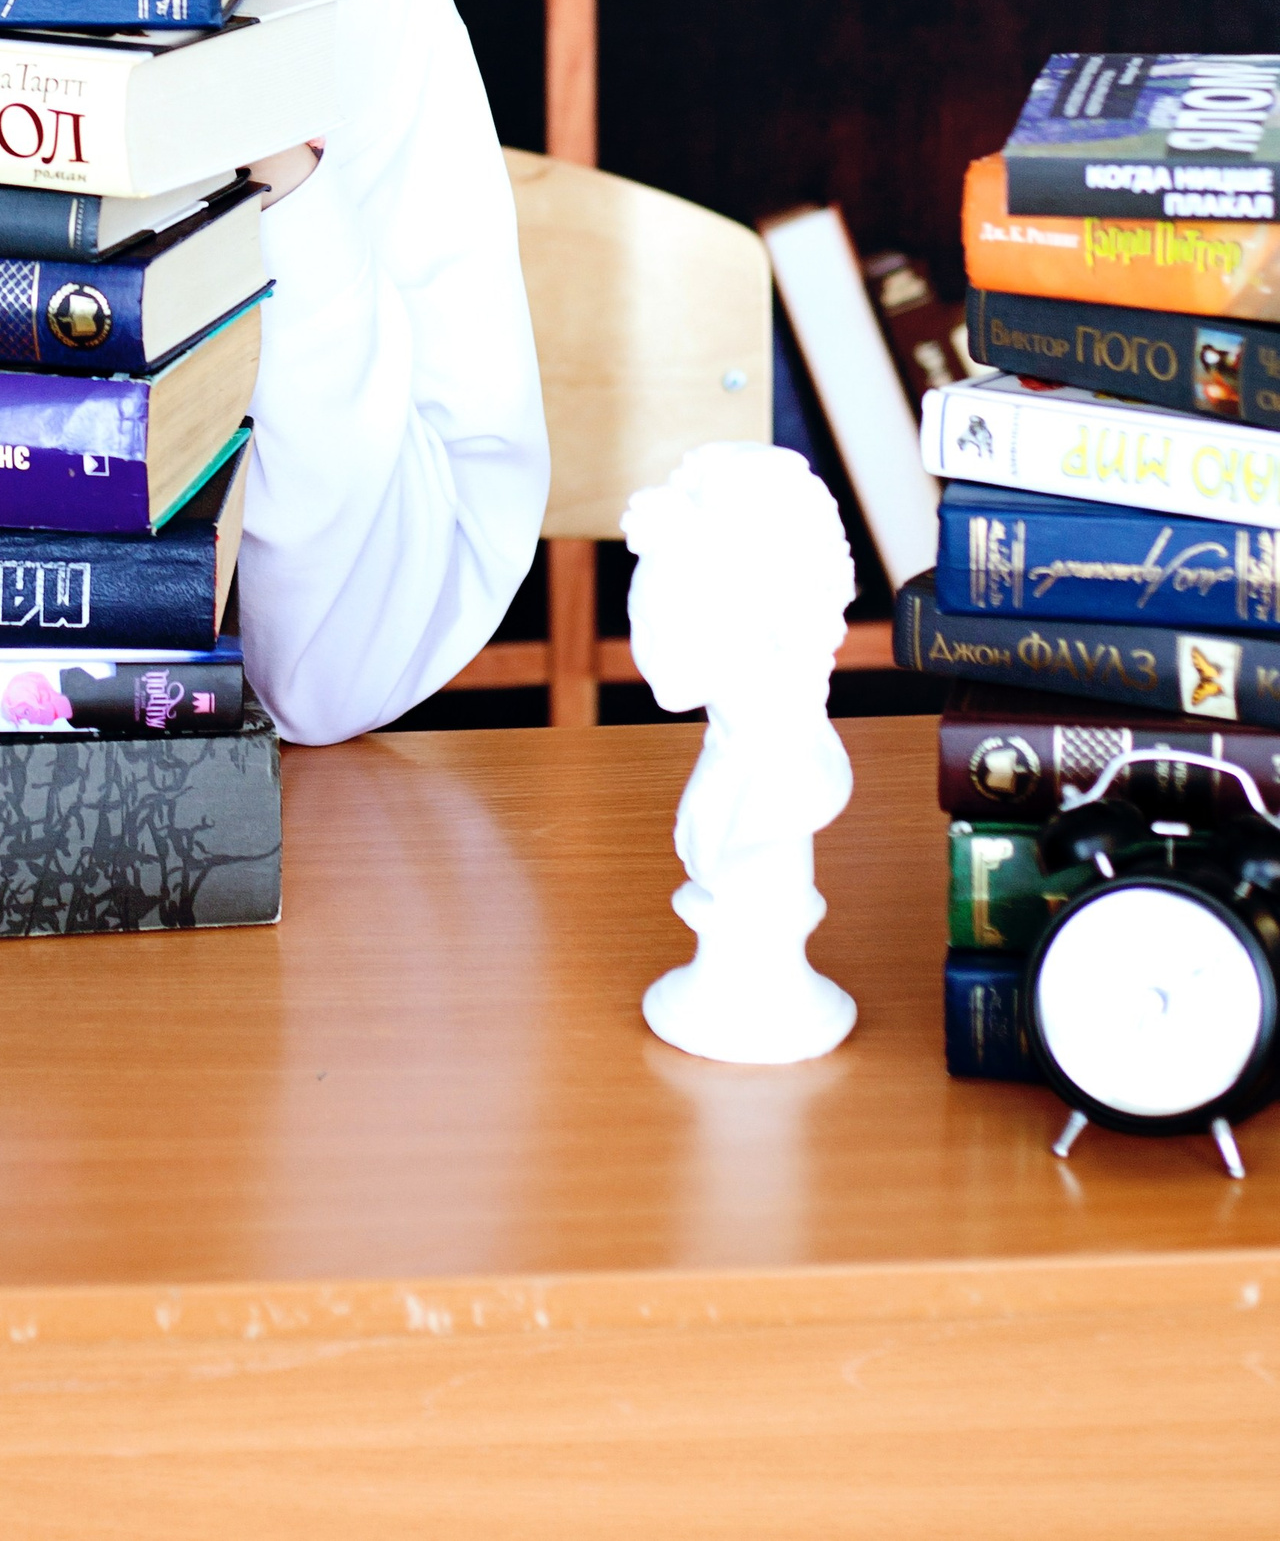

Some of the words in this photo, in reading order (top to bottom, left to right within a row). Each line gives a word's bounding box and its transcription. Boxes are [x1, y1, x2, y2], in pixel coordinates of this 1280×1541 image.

[17, 63, 88, 103] Тартт
[33, 167, 87, 183] роман
[1085, 164, 1173, 194] КОГДА
[1164, 193, 1275, 219] ПЛАКАЛ
[1019, 631, 1159, 692] ФАУЛЗ
